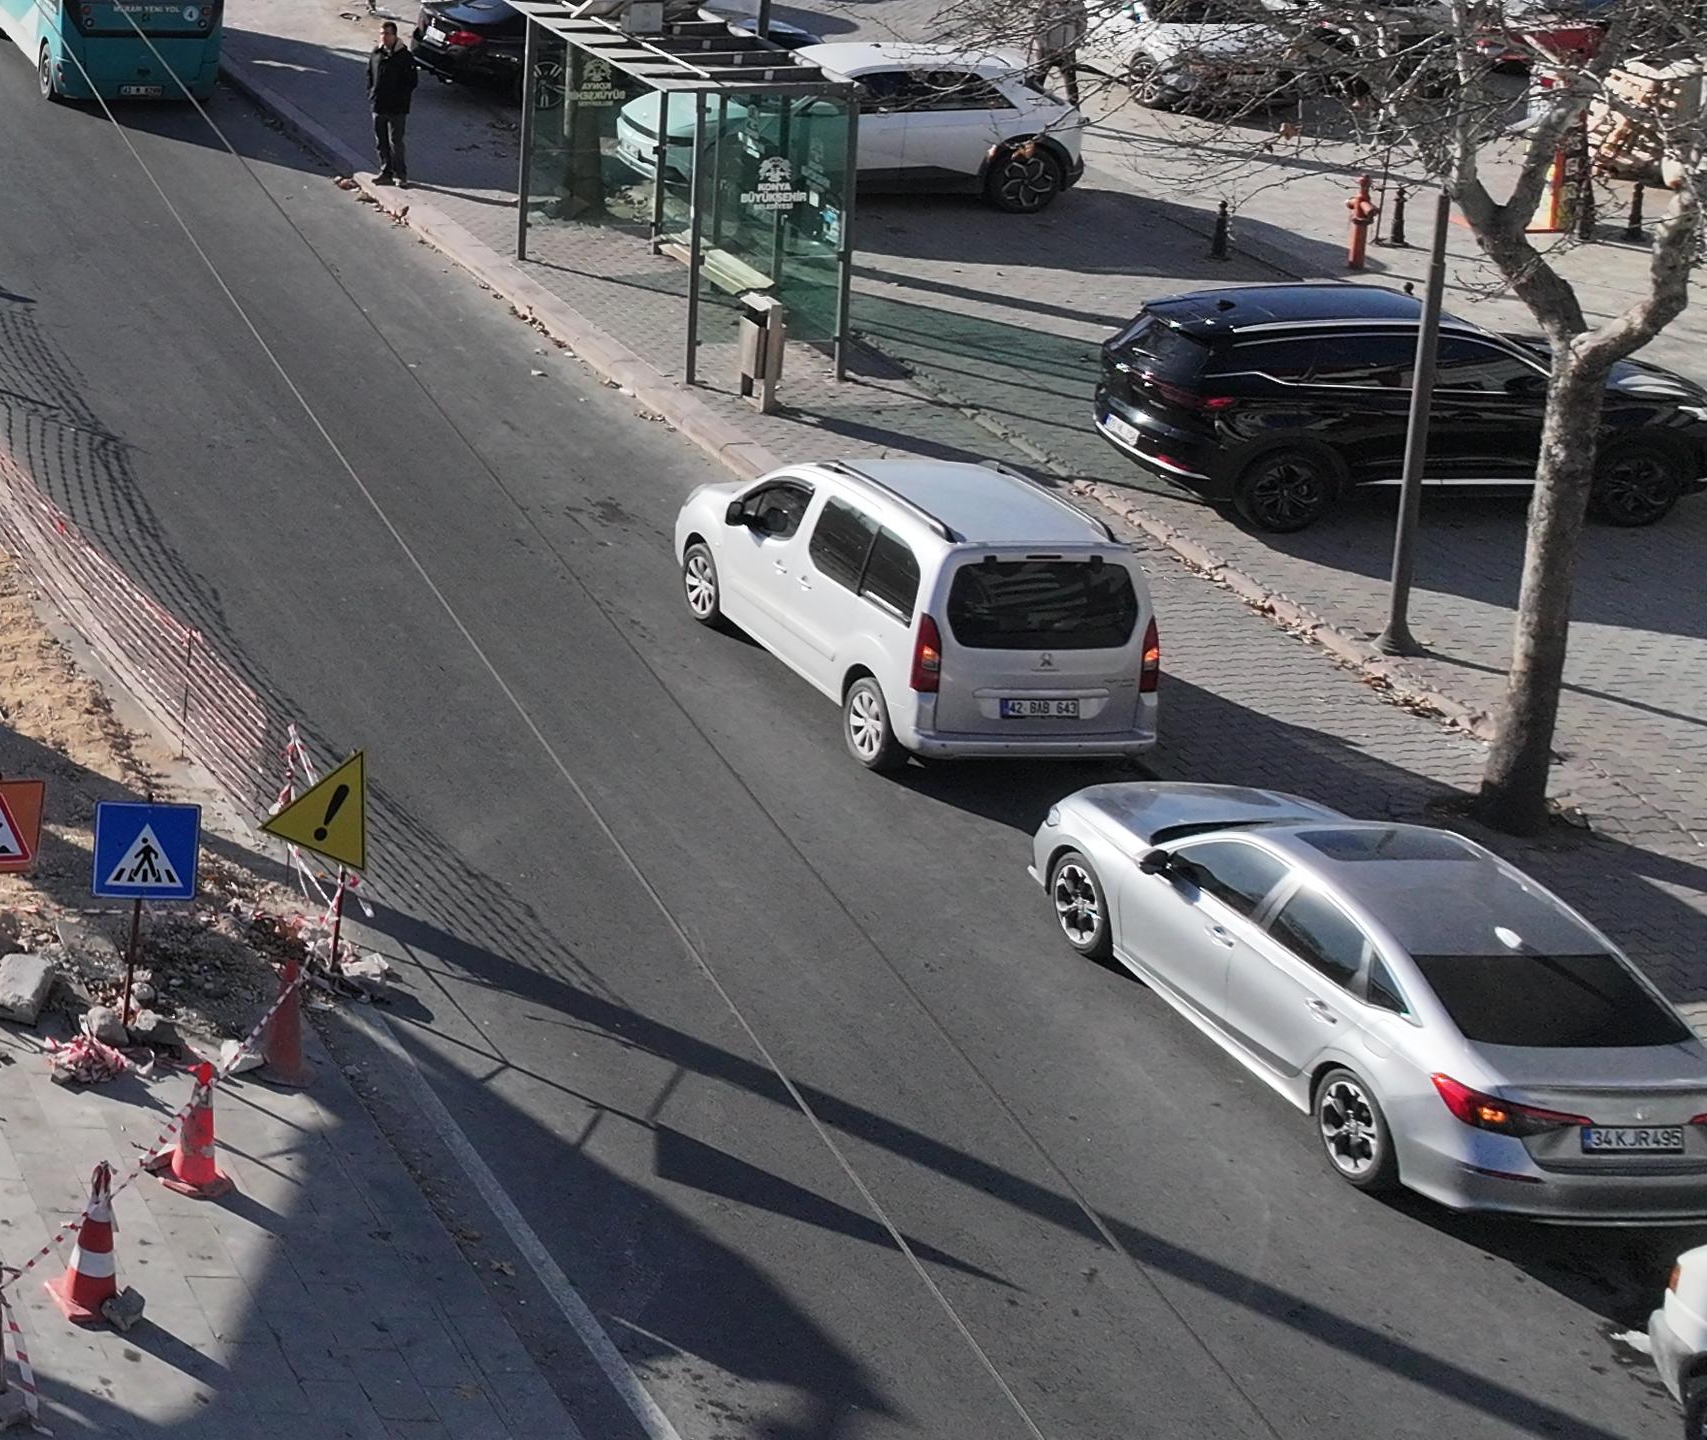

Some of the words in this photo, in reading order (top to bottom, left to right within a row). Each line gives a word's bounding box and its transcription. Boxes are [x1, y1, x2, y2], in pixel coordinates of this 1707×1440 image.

[757, 182, 791, 191] KONYA
[1010, 702, 1023, 714] 42
[1056, 702, 1078, 714] 643
